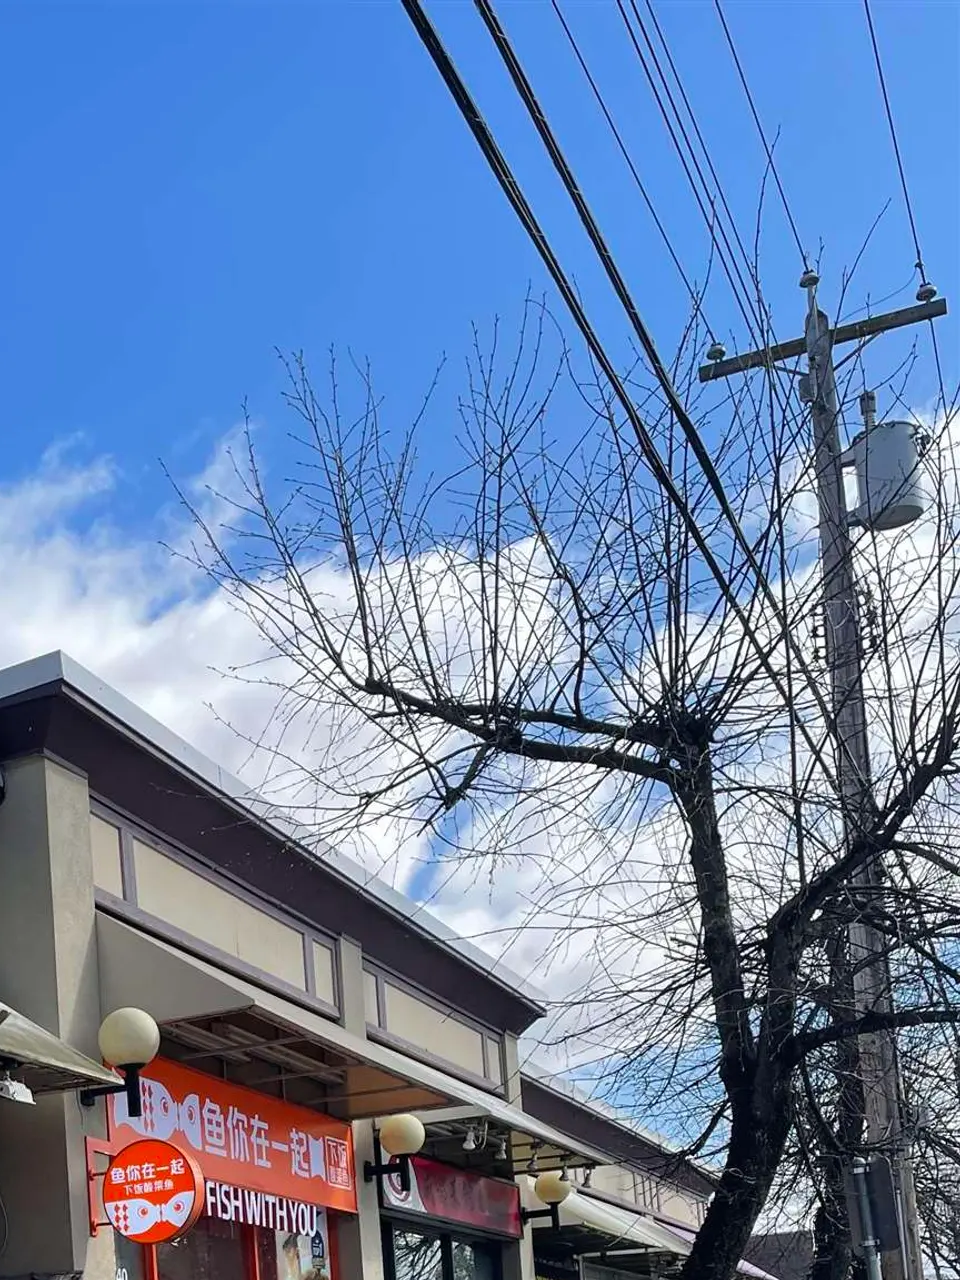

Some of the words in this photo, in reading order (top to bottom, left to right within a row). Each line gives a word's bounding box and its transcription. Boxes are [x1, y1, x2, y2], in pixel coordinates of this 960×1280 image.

[205, 1098, 310, 1179] 鱼你在一起
[111, 1158, 185, 1184] 鱼你在一起
[206, 1181, 244, 1223] FISH
[244, 1189, 288, 1232] WITH
[288, 1199, 317, 1237] YOU
